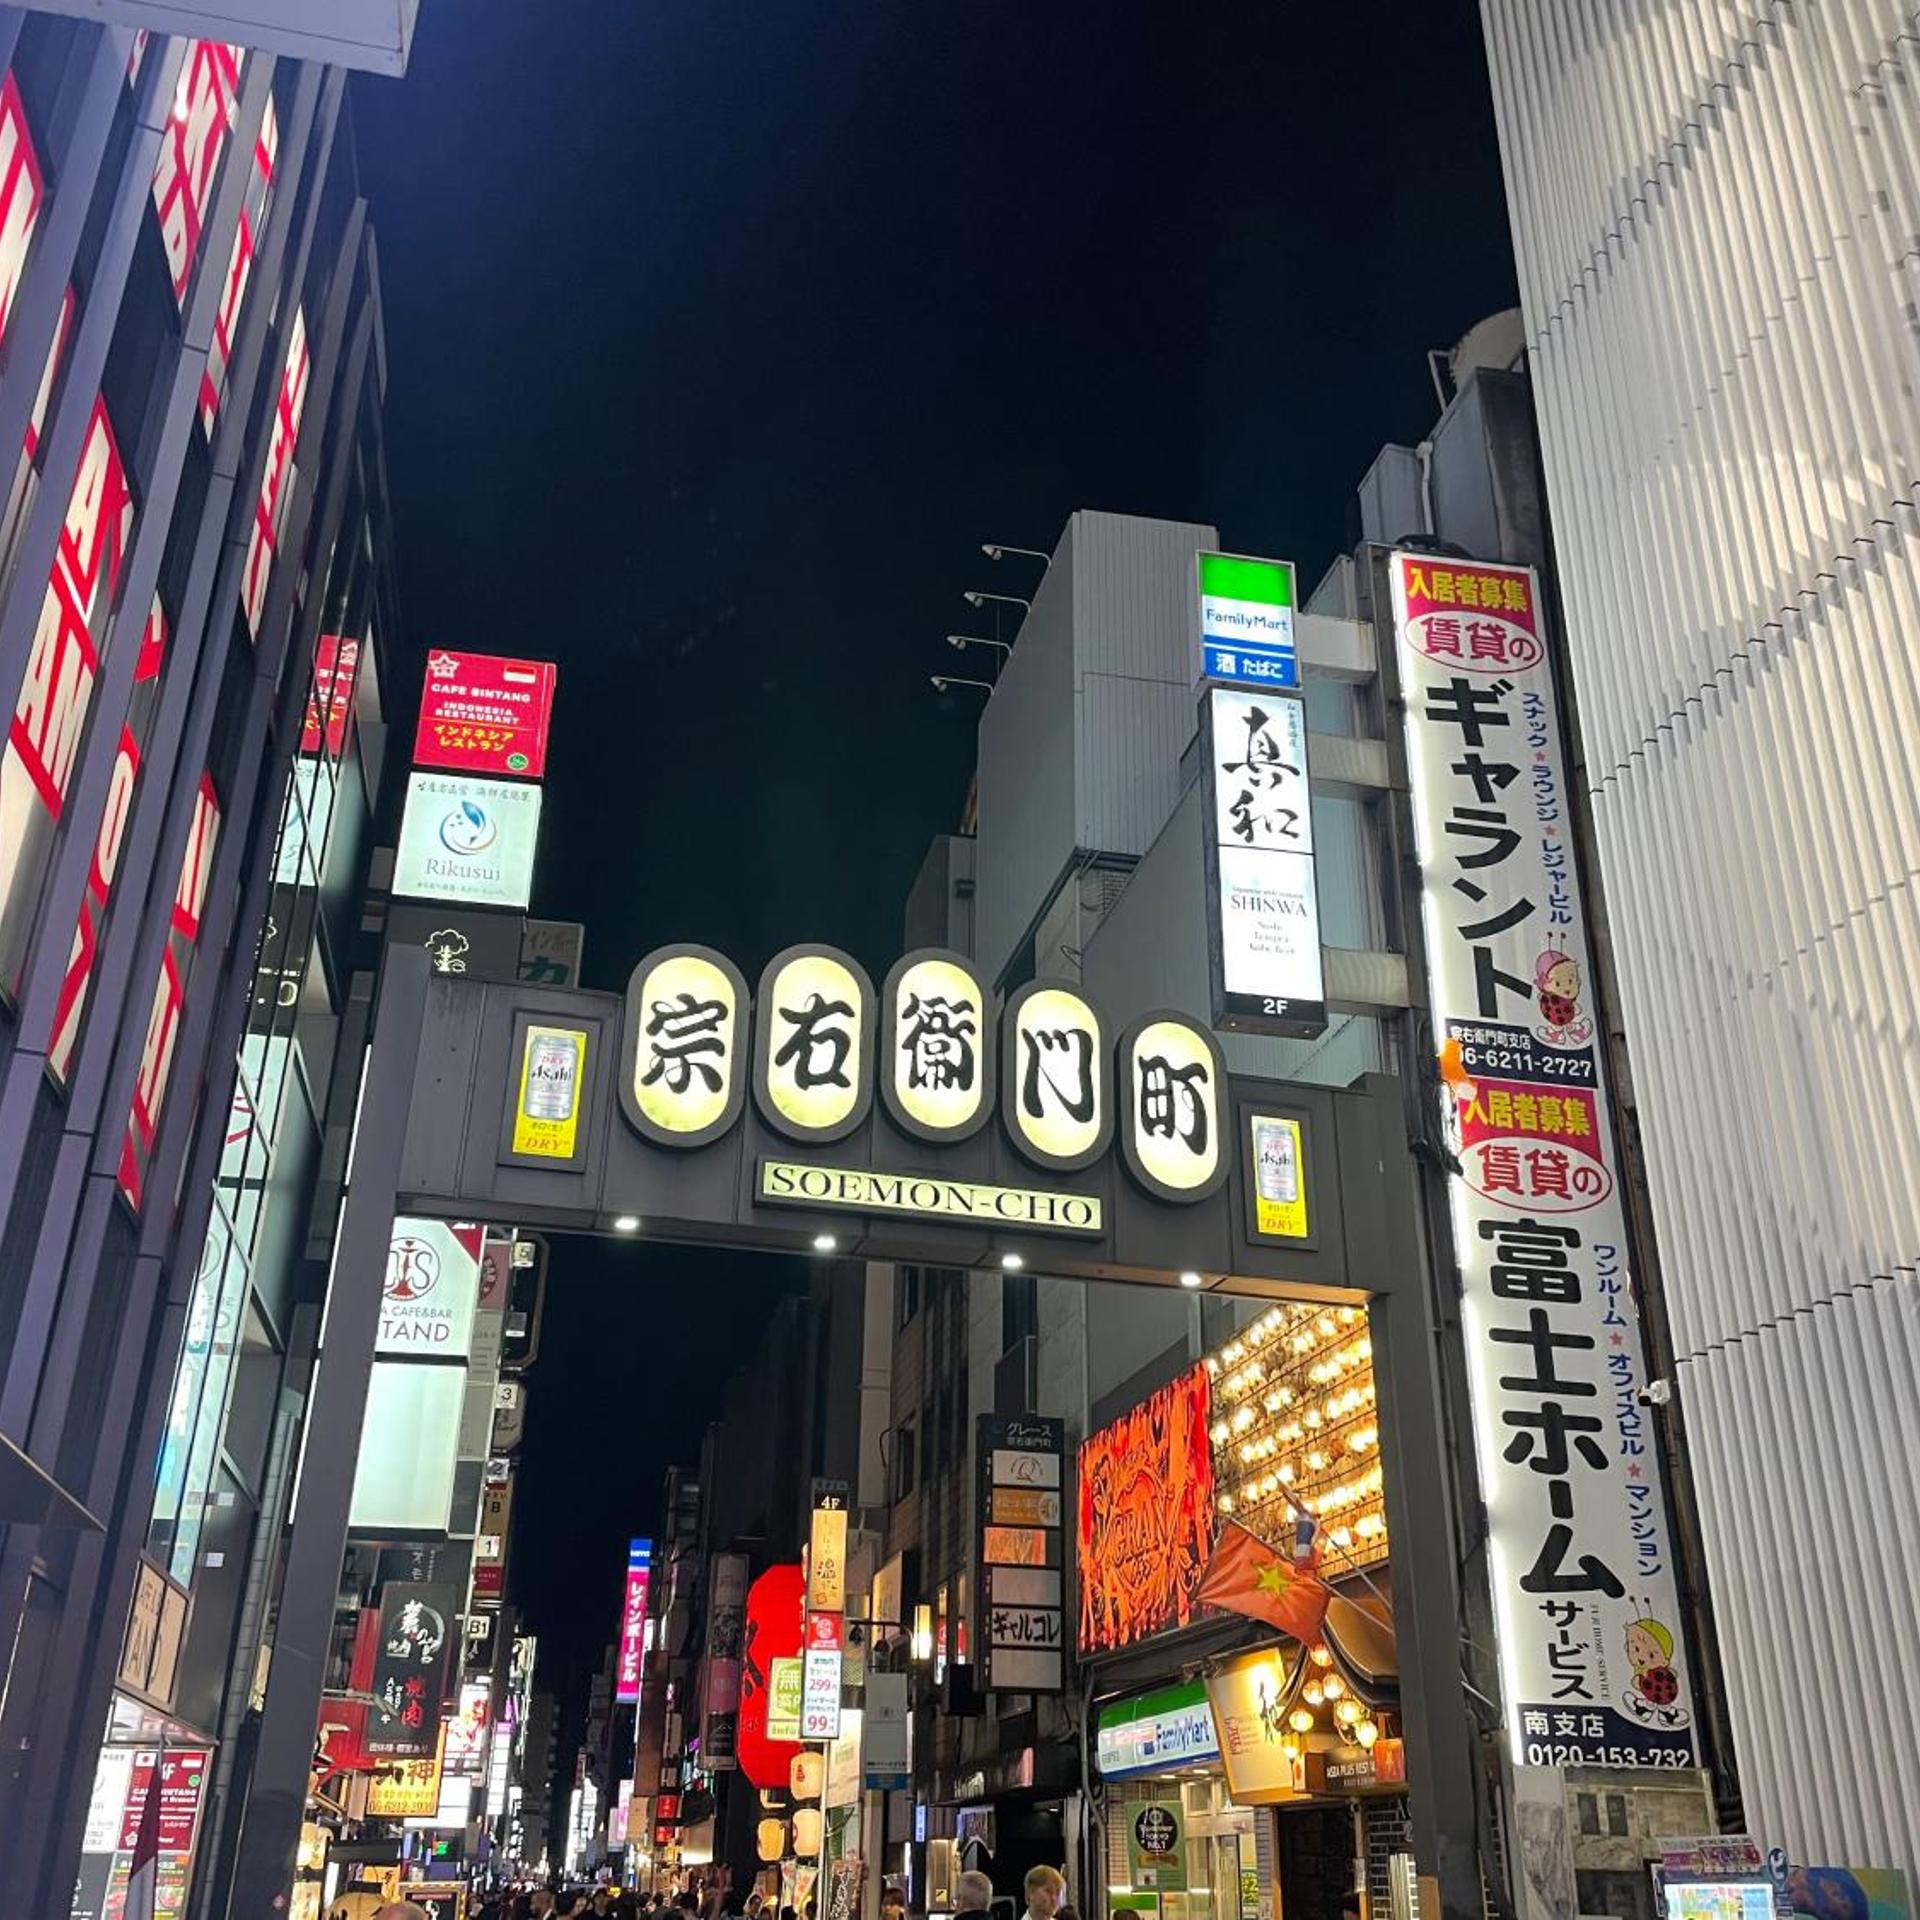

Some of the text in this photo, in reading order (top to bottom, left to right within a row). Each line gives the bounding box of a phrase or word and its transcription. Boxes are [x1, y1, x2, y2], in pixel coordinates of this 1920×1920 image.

[1408, 568, 1527, 613] 入居者募集
[1206, 608, 1289, 631] FamilyMart
[1420, 617, 1536, 664] 賃貸の
[1216, 652, 1283, 679] 酒 たばこ
[431, 684, 531, 703] CAFE BINTANG
[435, 708, 519, 725] RESTAURANT
[443, 702, 513, 716] INDONESIA
[434, 724, 514, 741] インドネシア
[439, 736, 505, 752] レストラン
[1523, 692, 1573, 925] スナック ラウンジ レジャービル
[1425, 677, 1536, 1019] ギャラント
[1231, 894, 1308, 917] SHINWA
[1263, 999, 1289, 1014] 2F
[531, 1064, 573, 1081] Asahi
[1458, 1049, 1593, 1078] 6-6211-2727
[1464, 1090, 1591, 1136] 入居者募集
[1260, 1152, 1294, 1167] Asahi
[1477, 1144, 1603, 1200] 賃貸の
[771, 1165, 1093, 1227] SOEMON-CHO
[381, 1320, 450, 1342] TAND
[502, 1387, 513, 1401] 3
[1478, 1218, 1626, 1599] 富士ホーム
[1594, 1244, 1628, 1328] ワンルーム
[1626, 1485, 1662, 1577] マンション
[1007, 1421, 1053, 1437] グレース
[821, 1495, 841, 1510] 4F
[470, 1620, 488, 1635] B1
[622, 1581, 645, 1683] レインボービル
[993, 1611, 1060, 1643] ギャルコレ
[1539, 1600, 1594, 1699] サービス
[1155, 1713, 1212, 1752] FamilyMart
[1523, 1711, 1605, 1738] 南支店
[1528, 1743, 1690, 1768] 0120-153-732
